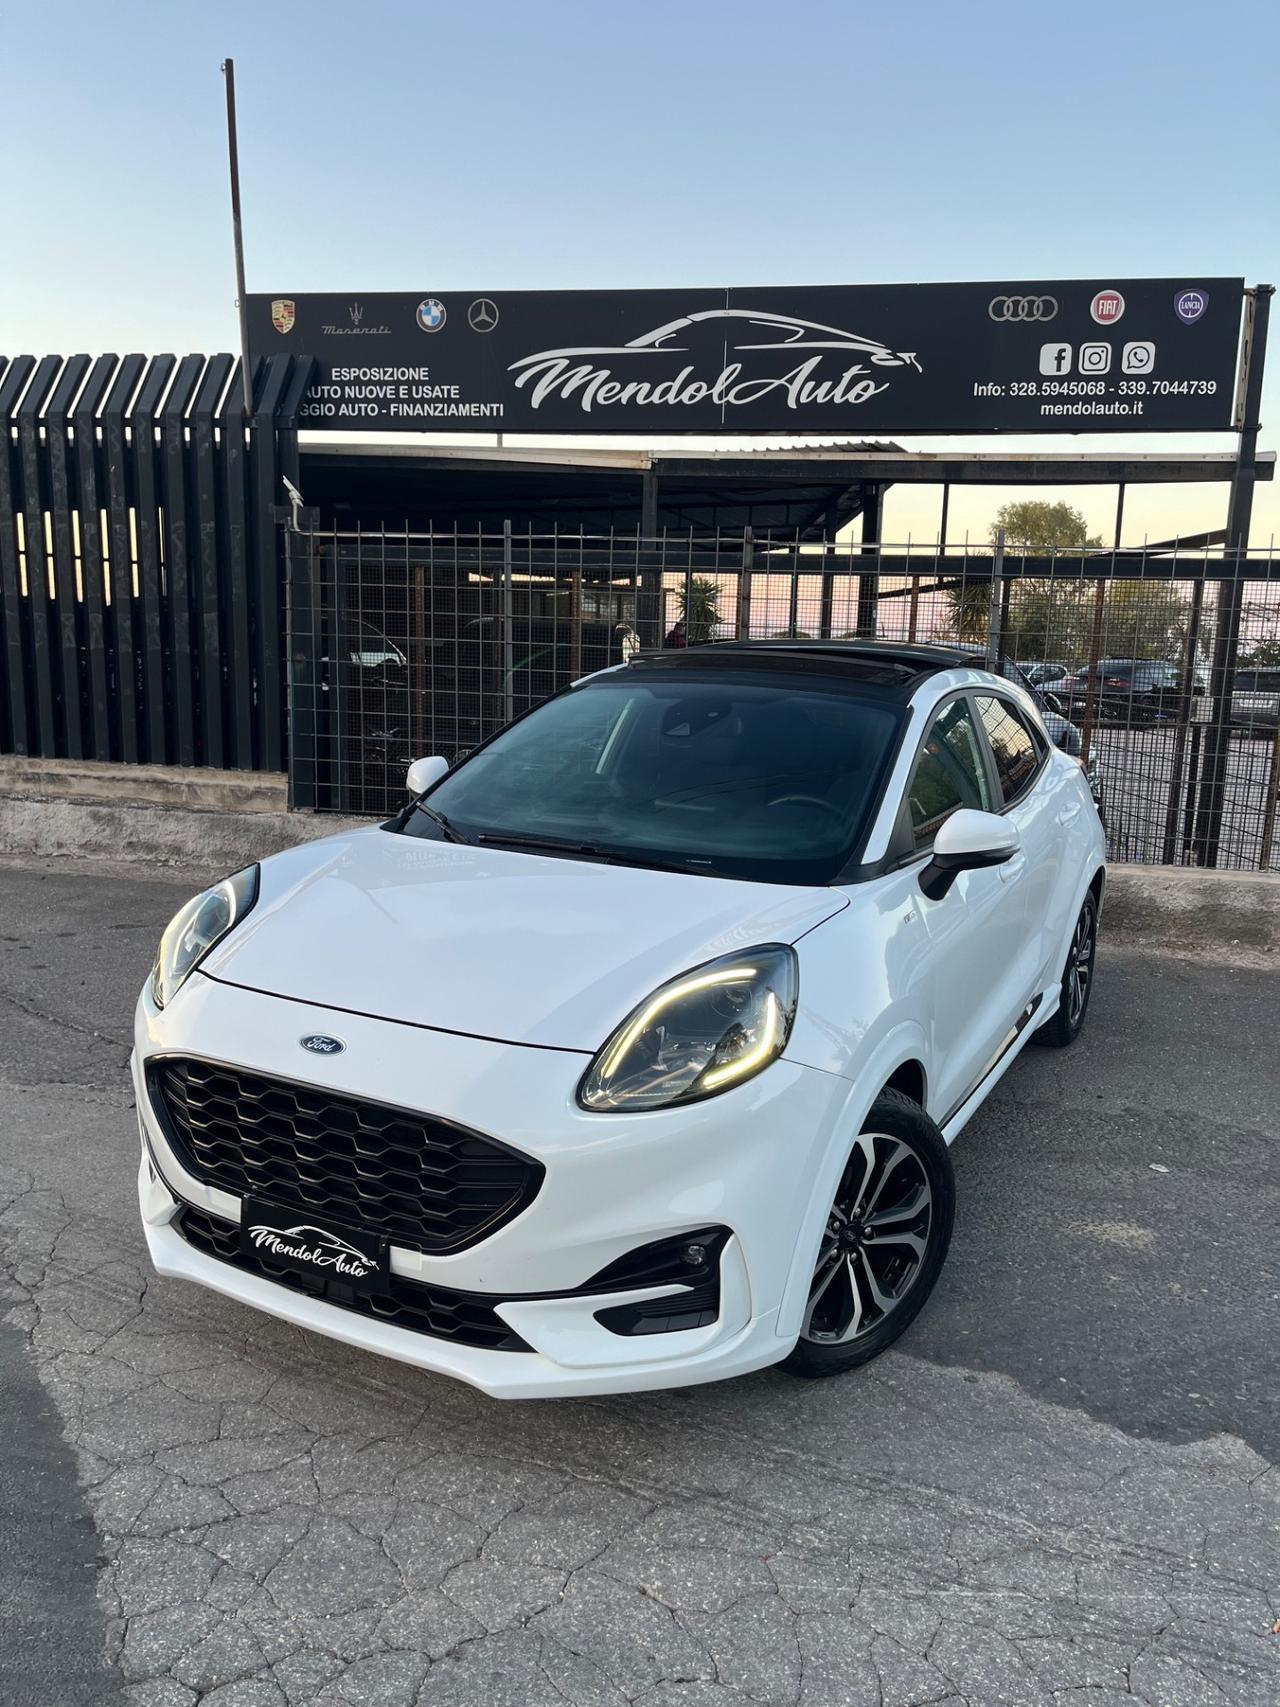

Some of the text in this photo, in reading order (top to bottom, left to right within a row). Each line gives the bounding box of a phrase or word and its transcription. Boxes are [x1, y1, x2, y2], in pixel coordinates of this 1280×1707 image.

[1098, 299, 1118, 315] FIAT
[321, 325, 392, 335] Maserati
[331, 367, 430, 381] ESPOSIZIONE
[344, 385, 396, 399] NUOVE
[399, 385, 409, 399] E
[412, 385, 460, 399] USATE
[973, 382, 1006, 397] Info:
[1009, 381, 1105, 396] 328.5945068
[1118, 380, 1217, 395] 339.7044739
[338, 403, 379, 417] AUTO
[390, 403, 505, 417] FINANZIAMENTI
[1040, 400, 1144, 416] mendolauto.it
[306, 1036, 337, 1052] Ford
